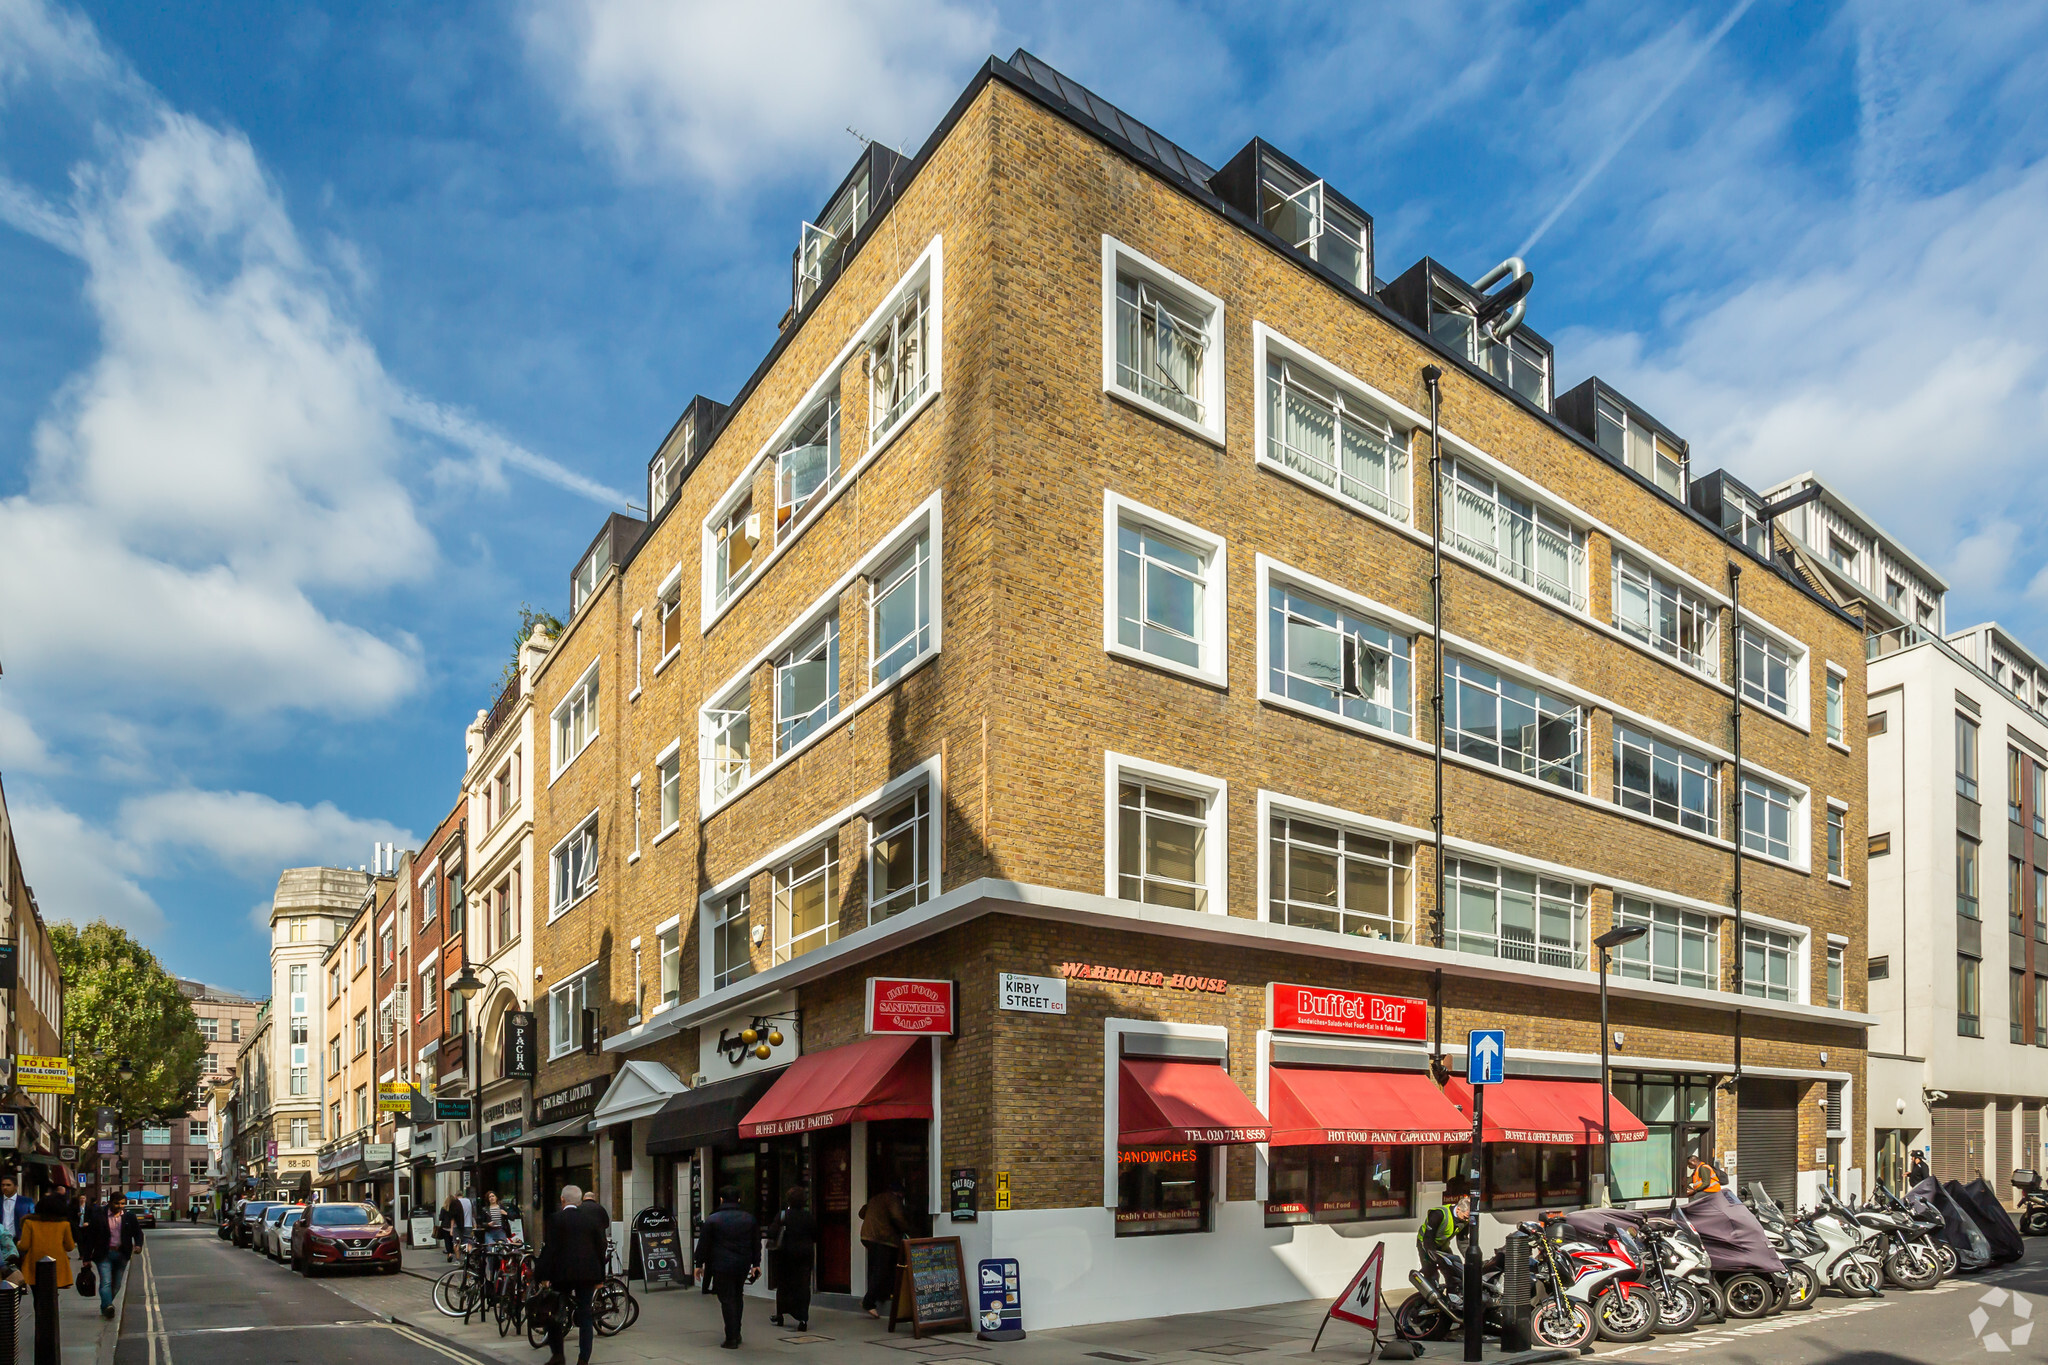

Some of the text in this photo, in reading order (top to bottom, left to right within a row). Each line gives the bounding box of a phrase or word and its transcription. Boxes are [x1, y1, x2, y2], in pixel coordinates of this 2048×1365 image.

[1062, 962, 1227, 993] WARRINER HOUSE
[887, 984, 939, 1001] HOT FOOD
[1006, 981, 1039, 994] KIRBY
[879, 1002, 945, 1014] SANDWICHES
[1006, 994, 1063, 1010] STREET EC1
[1298, 990, 1406, 1023] Buffet Bar
[892, 1015, 932, 1029] SALADS
[1298, 1016, 1325, 1026] Sandwiches
[1327, 1019, 1343, 1027] Salads
[1395, 1025, 1406, 1033] Away
[515, 1028, 525, 1070] PACHA
[755, 1113, 834, 1135] BUFFET & OFFICE PARTIES
[1207, 1130, 1224, 1140] 020
[1225, 1130, 1245, 1140] 7242
[1246, 1129, 1266, 1140] 8558
[1328, 1131, 1345, 1142] HOT
[1347, 1131, 1367, 1142] FOOD
[1371, 1132, 1397, 1142] PANINI
[1400, 1131, 1441, 1142] CAPPUCCINO
[1505, 1130, 1527, 1141] BUFFET
[1527, 1131, 1532, 1141] &
[1532, 1132, 1551, 1142] OFFICE
[1551, 1133, 1574, 1143] PARTIES
[287, 1159, 311, 1168] 88-90
[1118, 1150, 1197, 1163] SANDWICHES
[951, 1178, 976, 1190] SALT BEEF
[998, 1173, 1009, 1189] H
[998, 1192, 1009, 1208] H
[1117, 1209, 1200, 1221] reshly Cut Sandwiches
